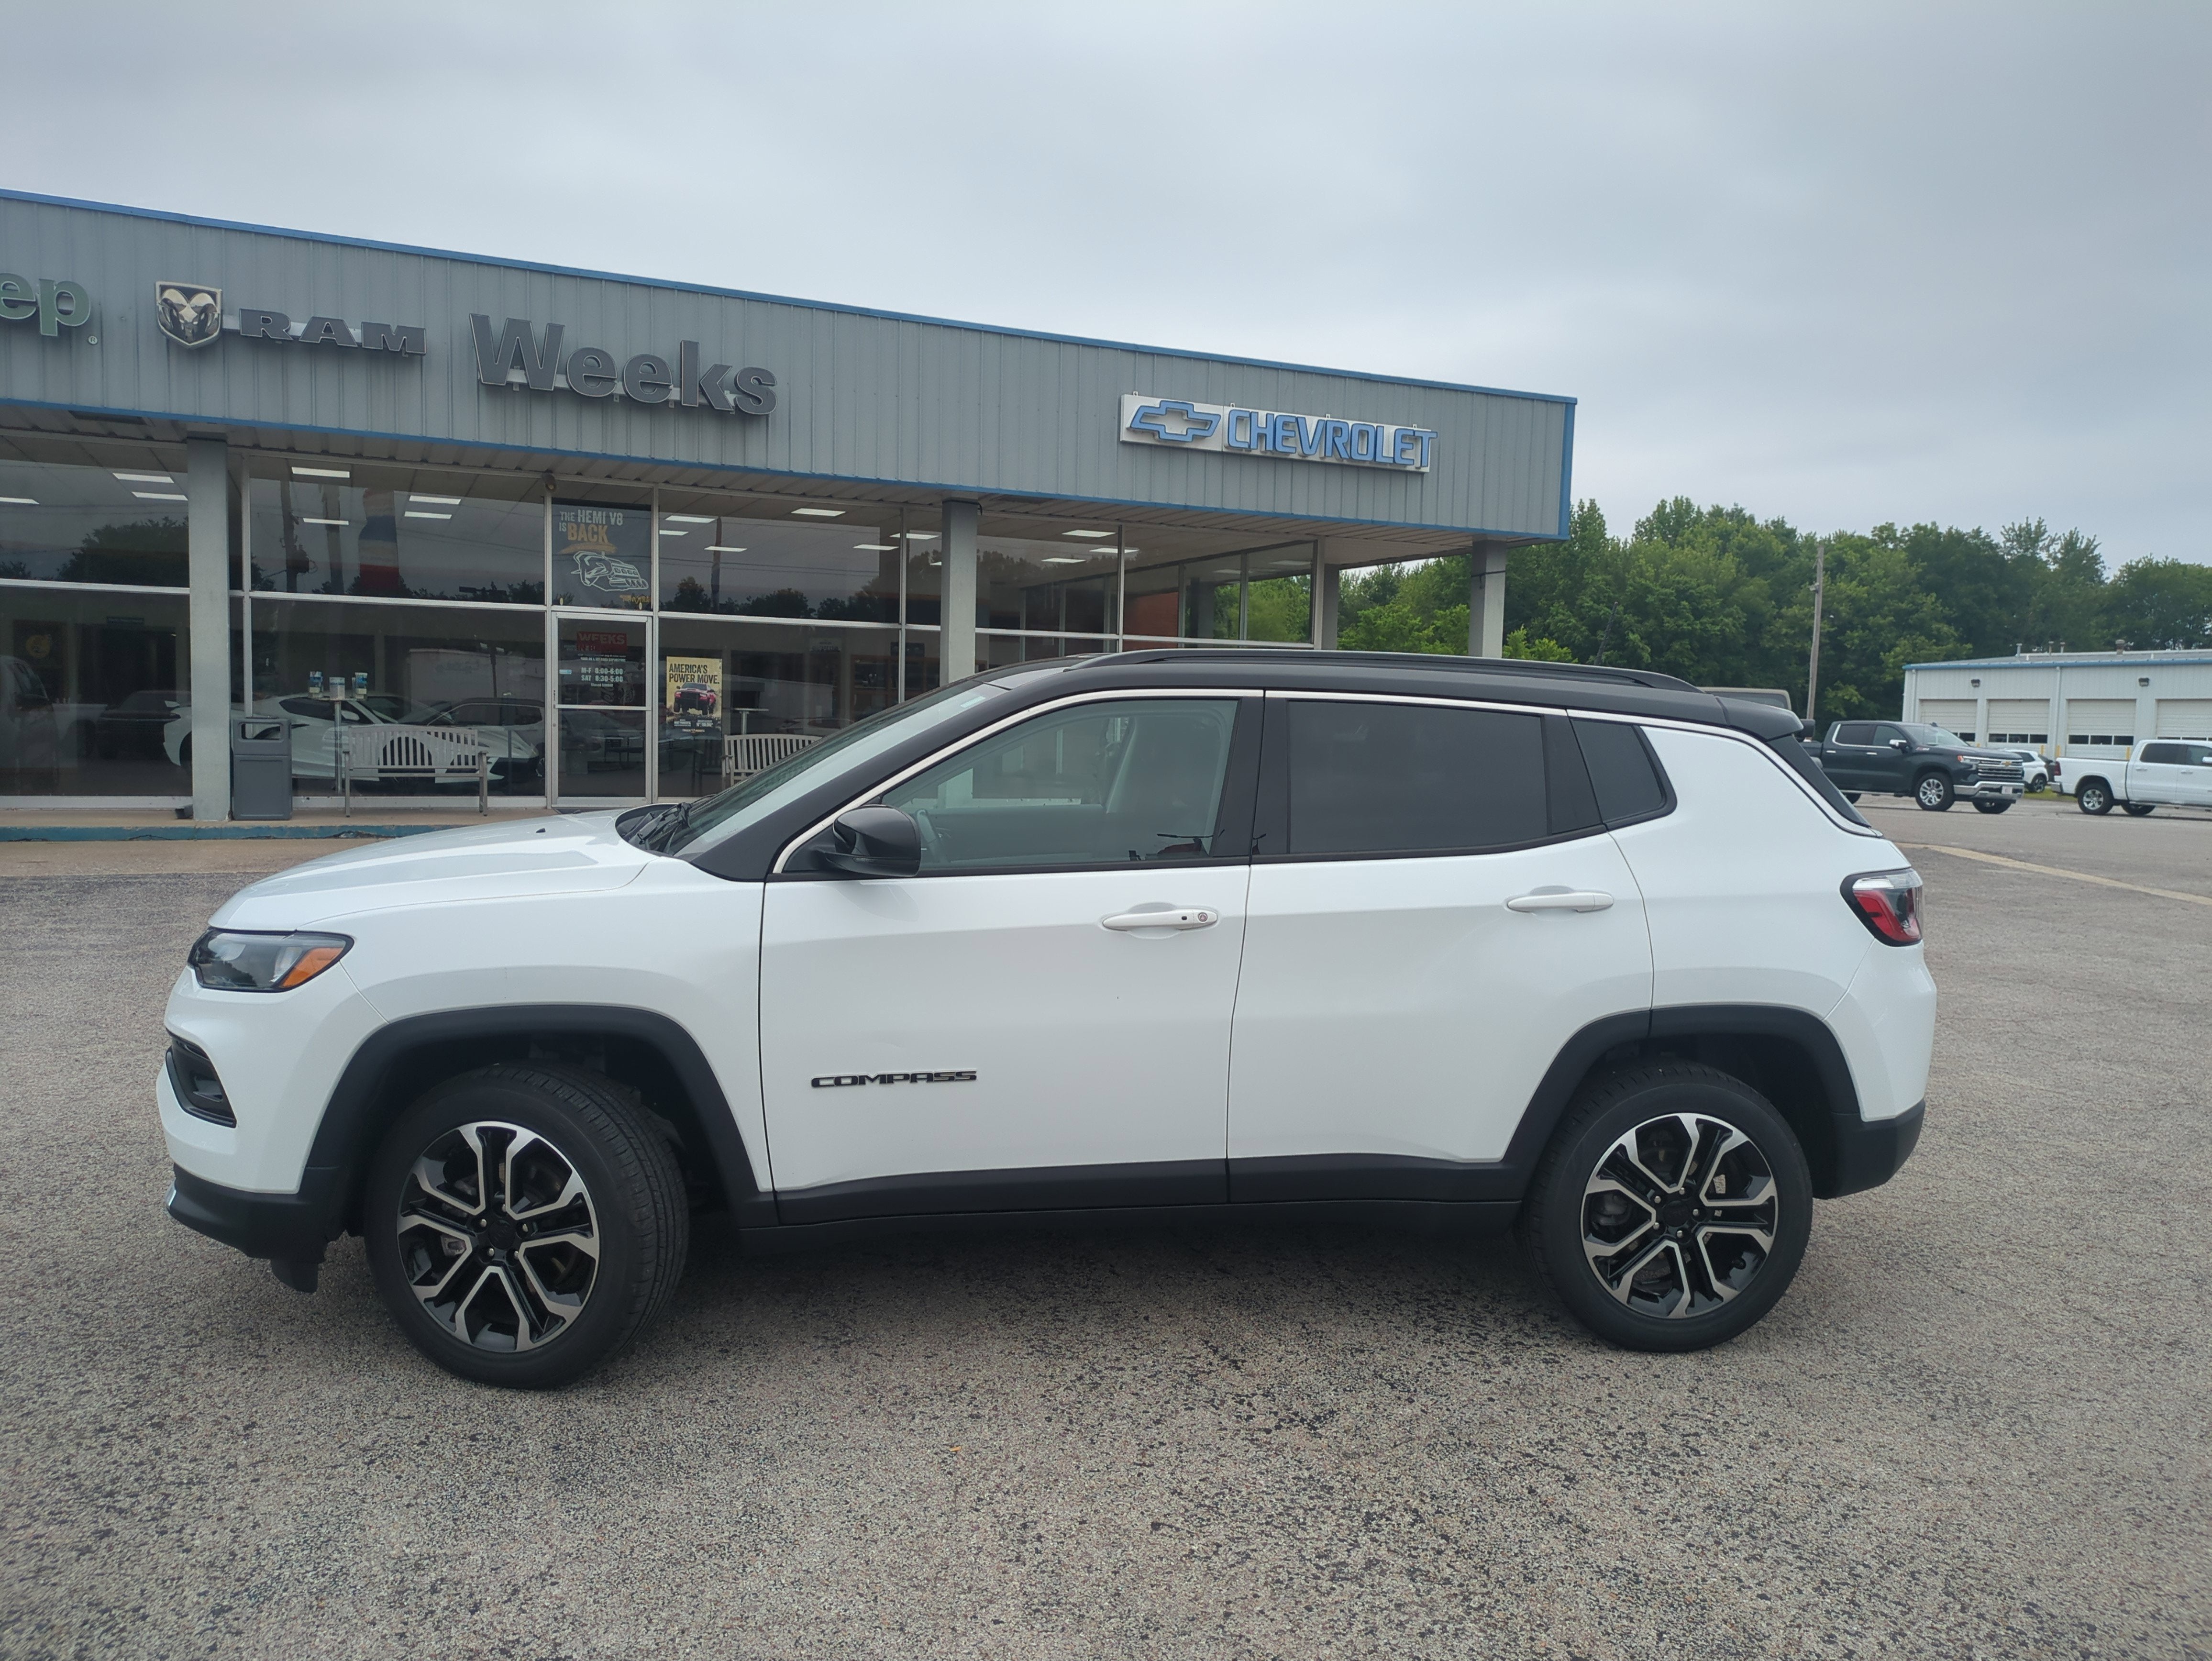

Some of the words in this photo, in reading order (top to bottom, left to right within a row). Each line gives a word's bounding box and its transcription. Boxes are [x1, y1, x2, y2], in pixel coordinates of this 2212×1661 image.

[240, 308, 426, 354] RAM
[469, 313, 777, 415] Weeks
[1228, 409, 1438, 467] CHEVROLET
[560, 511, 575, 521] THE
[577, 509, 606, 524] HEMI
[609, 512, 623, 526] V8
[559, 522, 566, 532] IS
[567, 523, 608, 543] BACK
[669, 663, 708, 674] AMERICA'S
[669, 673, 695, 683] POWER
[697, 674, 719, 684] MOVE.
[811, 1071, 977, 1088] COMPASS
